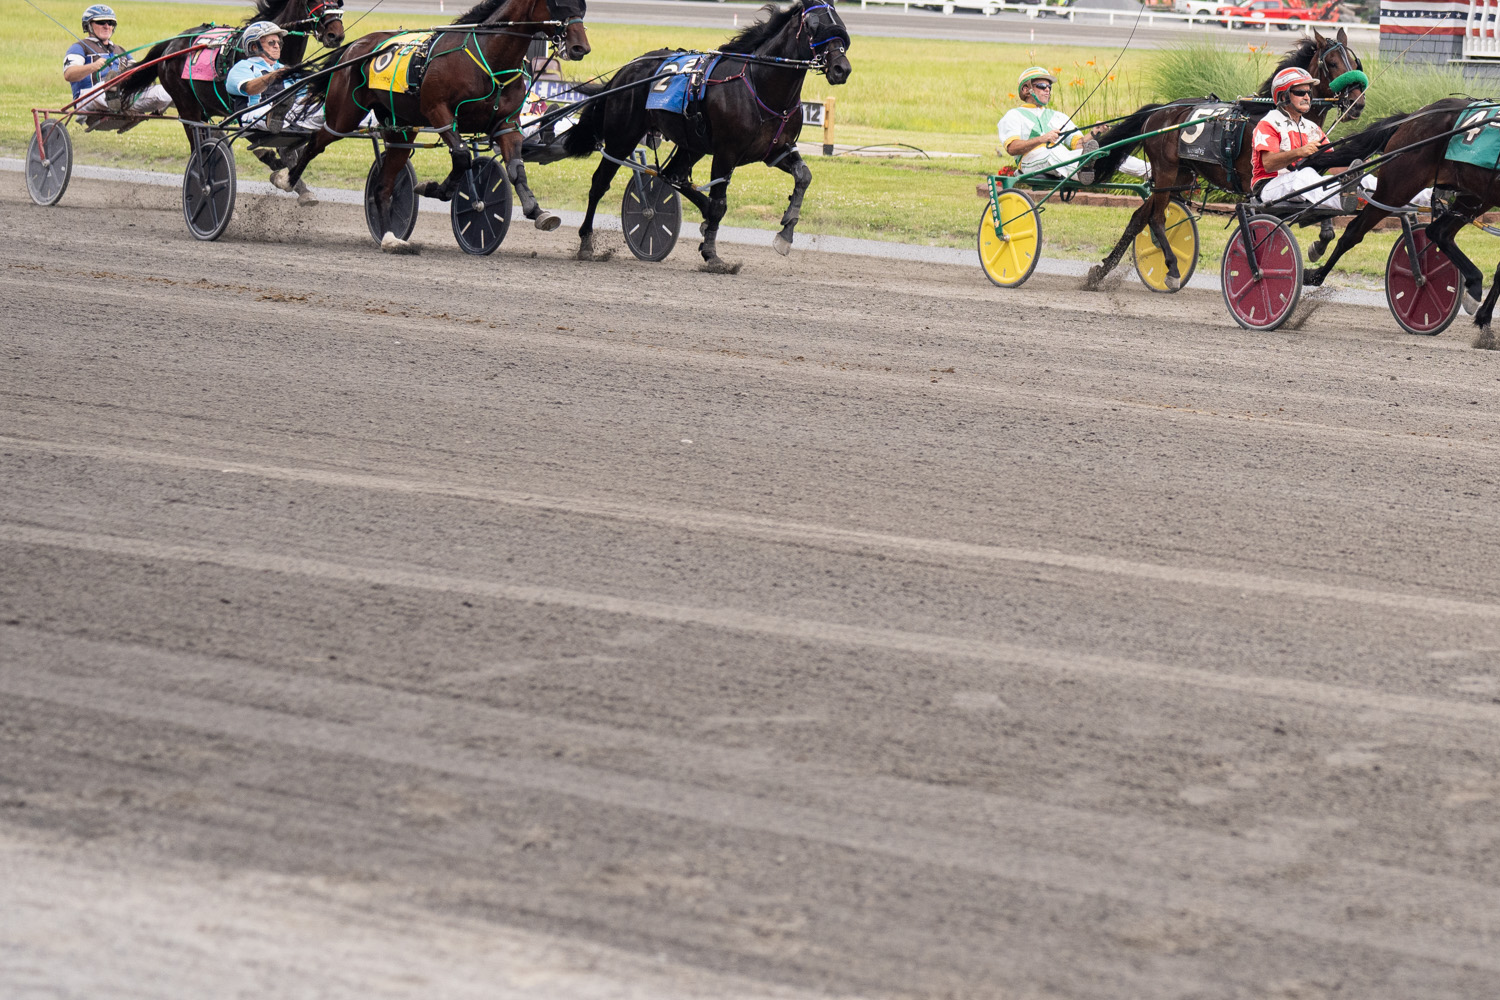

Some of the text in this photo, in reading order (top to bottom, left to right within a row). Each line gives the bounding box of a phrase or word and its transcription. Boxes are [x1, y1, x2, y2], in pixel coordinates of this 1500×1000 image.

[653, 58, 698, 91] 2 2
[805, 104, 821, 122] 12
[1180, 108, 1215, 144] 5
[1459, 109, 1489, 143] 4
